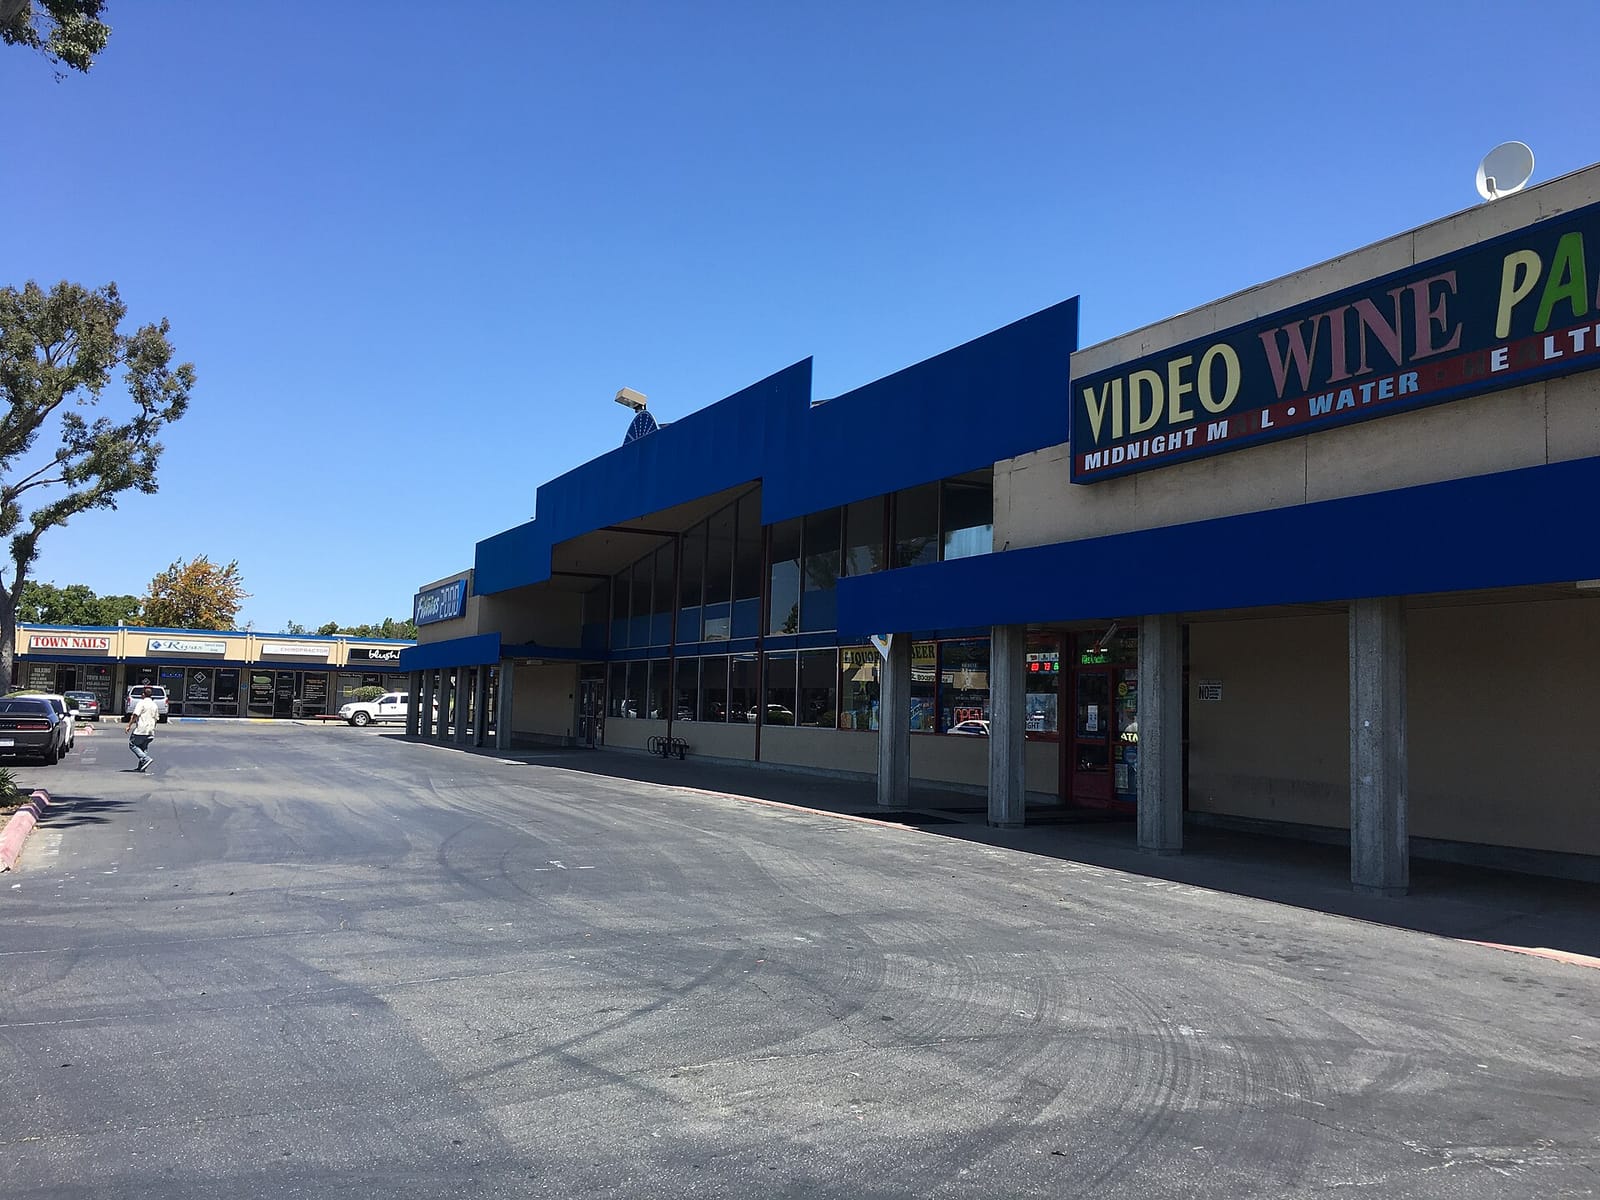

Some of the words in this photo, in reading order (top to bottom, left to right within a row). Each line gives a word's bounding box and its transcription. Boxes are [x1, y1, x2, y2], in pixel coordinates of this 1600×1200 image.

[1083, 343, 1241, 445] VIDEO
[1259, 270, 1463, 398] WINE
[1495, 231, 1600, 339] PA
[1084, 427, 1197, 471] MIDNIGHT
[1308, 371, 1419, 417] WATER
[33, 637, 69, 647] TOWN
[72, 638, 107, 648] NAILS
